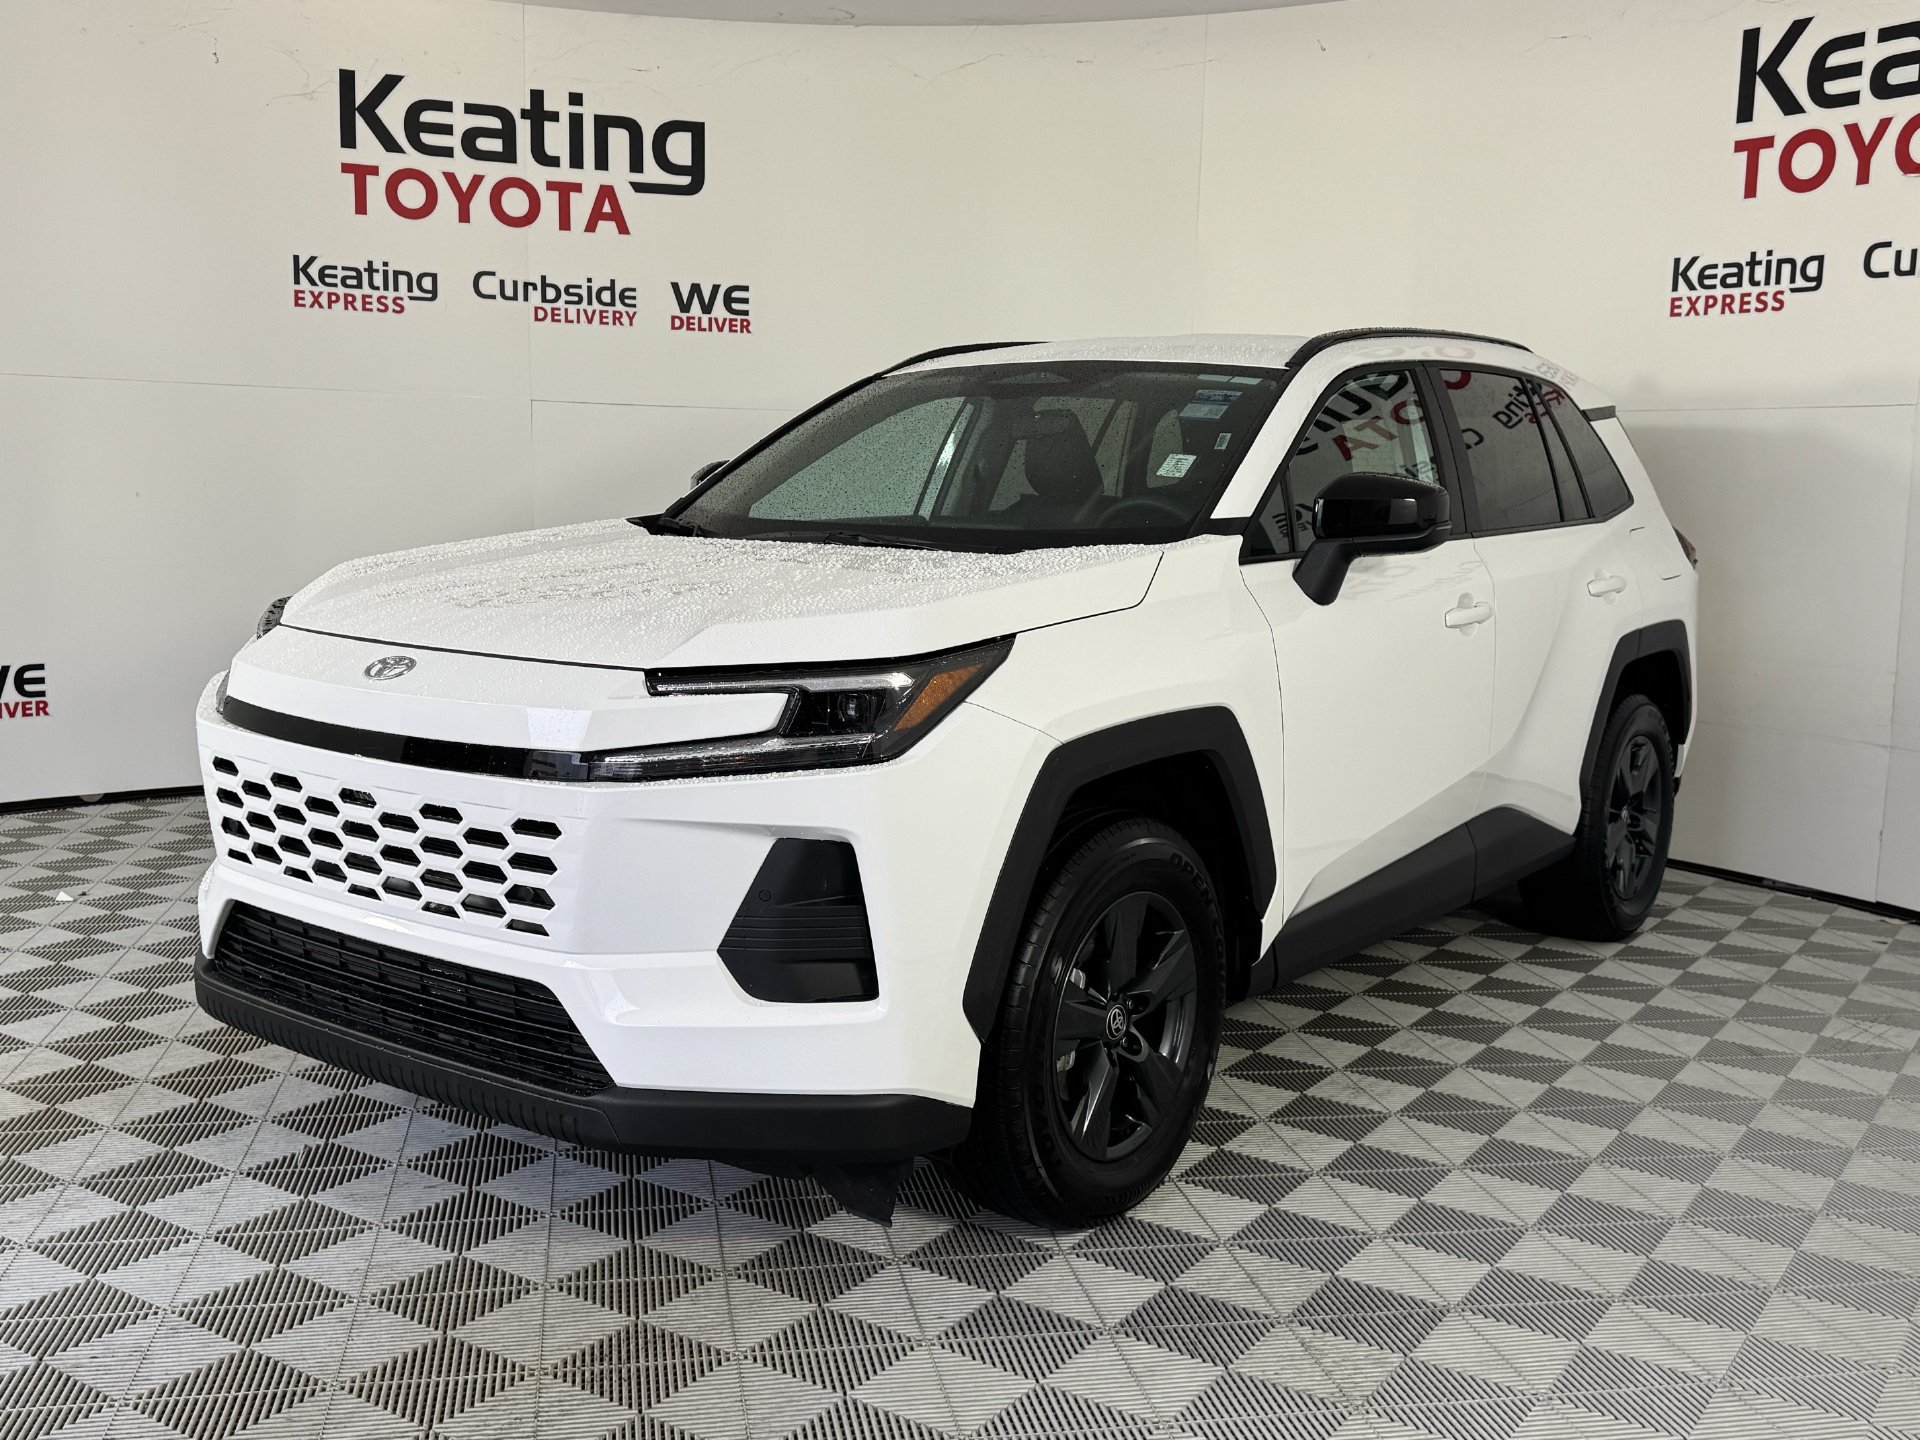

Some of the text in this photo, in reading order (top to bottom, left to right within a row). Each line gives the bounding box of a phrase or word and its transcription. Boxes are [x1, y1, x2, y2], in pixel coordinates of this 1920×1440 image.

[339, 69, 705, 196] Keating
[341, 162, 630, 235] TOYOTA
[292, 254, 437, 302] Keating
[472, 271, 637, 308] Curbside
[1671, 250, 1825, 293] Keating
[293, 289, 405, 314] EXPRESS
[533, 307, 637, 326] DELIVERY
[671, 282, 750, 316] WE
[1669, 290, 1785, 318] EXPRESS
[670, 315, 751, 333] DELIVER
[0, 663, 46, 699] E
